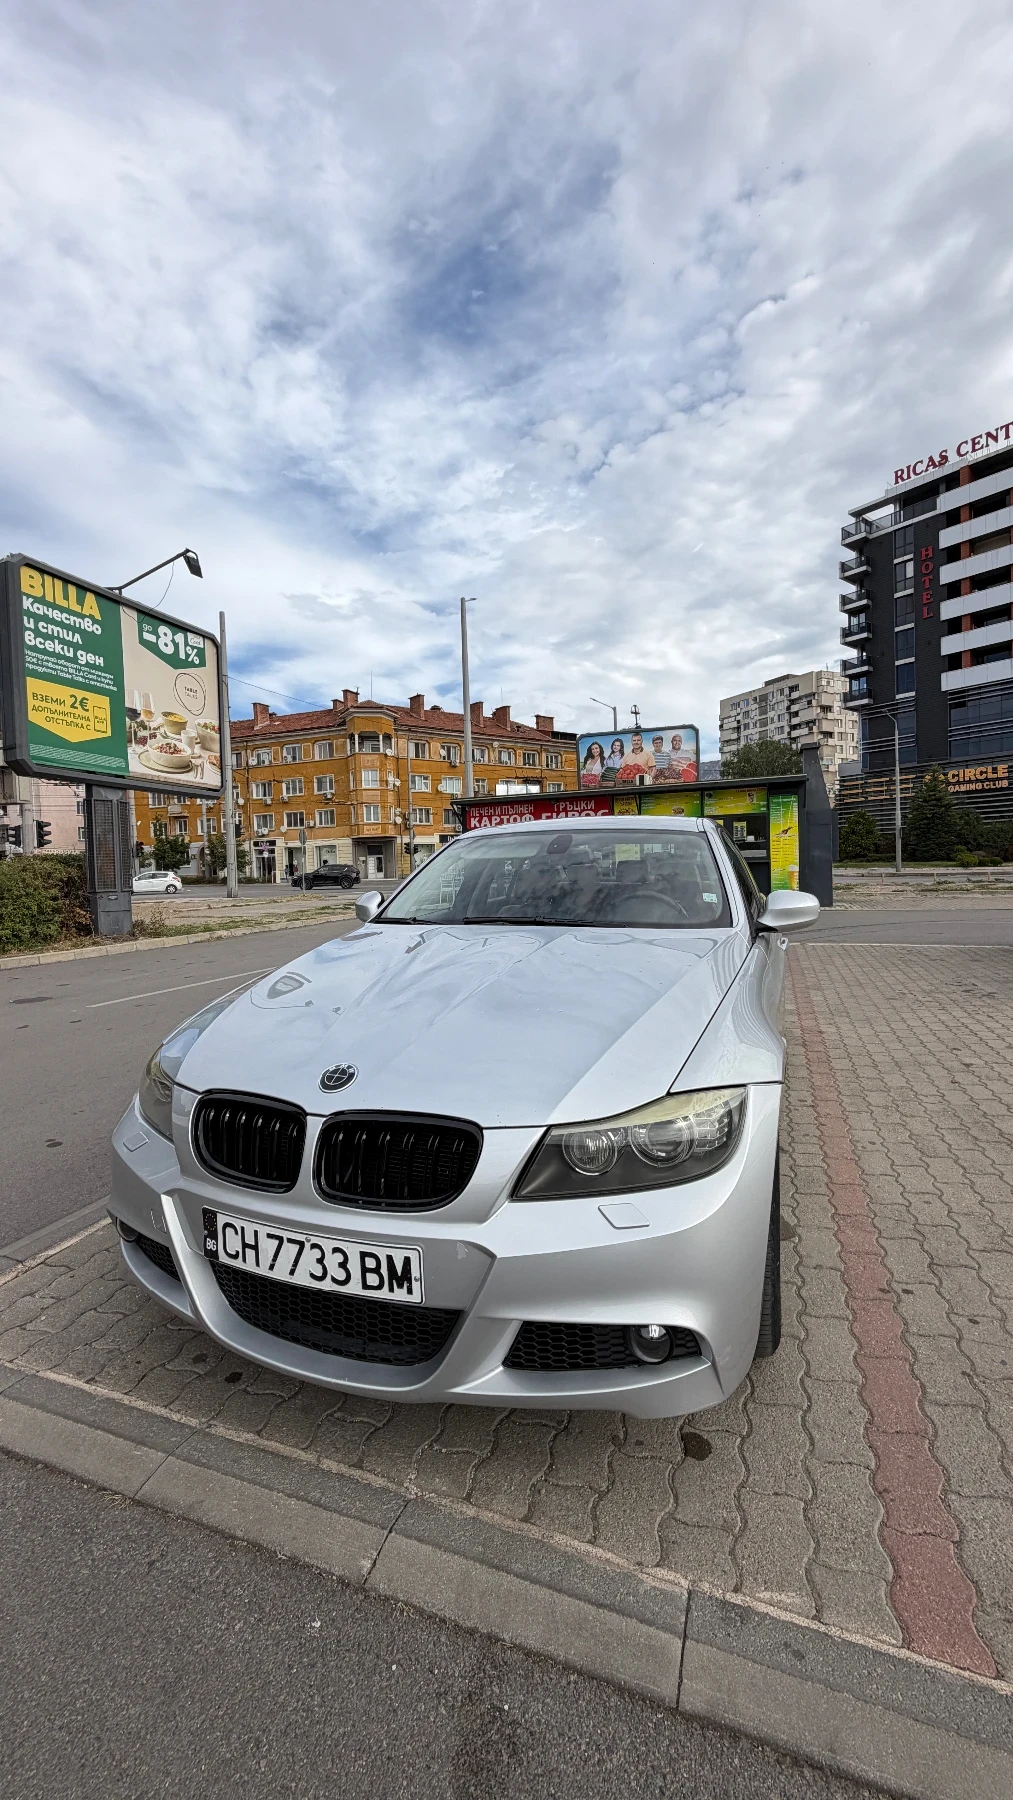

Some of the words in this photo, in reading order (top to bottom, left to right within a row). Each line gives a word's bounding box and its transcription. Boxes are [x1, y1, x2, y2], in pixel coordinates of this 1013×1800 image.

[894, 449, 950, 485] RICAS
[920, 545, 934, 619] HOTEL
[20, 566, 102, 621] BILLA
[22, 595, 102, 635] Качество
[23, 619, 34, 631] и
[38, 624, 82, 644] стил
[77, 648, 104, 667] ден
[32, 692, 66, 706] ВЗЕМИ
[69, 694, 90, 712] 2€
[32, 704, 91, 722] ДОПЪЛНИТЕЛНА
[45, 715, 85, 730] ОТСТЪПКА
[948, 764, 1009, 783] CIRCLE
[948, 783, 982, 792] GAMING
[983, 780, 1008, 788] CLUB
[470, 806, 494, 816] ПЕЧЕН
[495, 805, 501, 815] И
[502, 804, 534, 815] ПЪЛНЕН
[206, 1238, 217, 1251] BG
